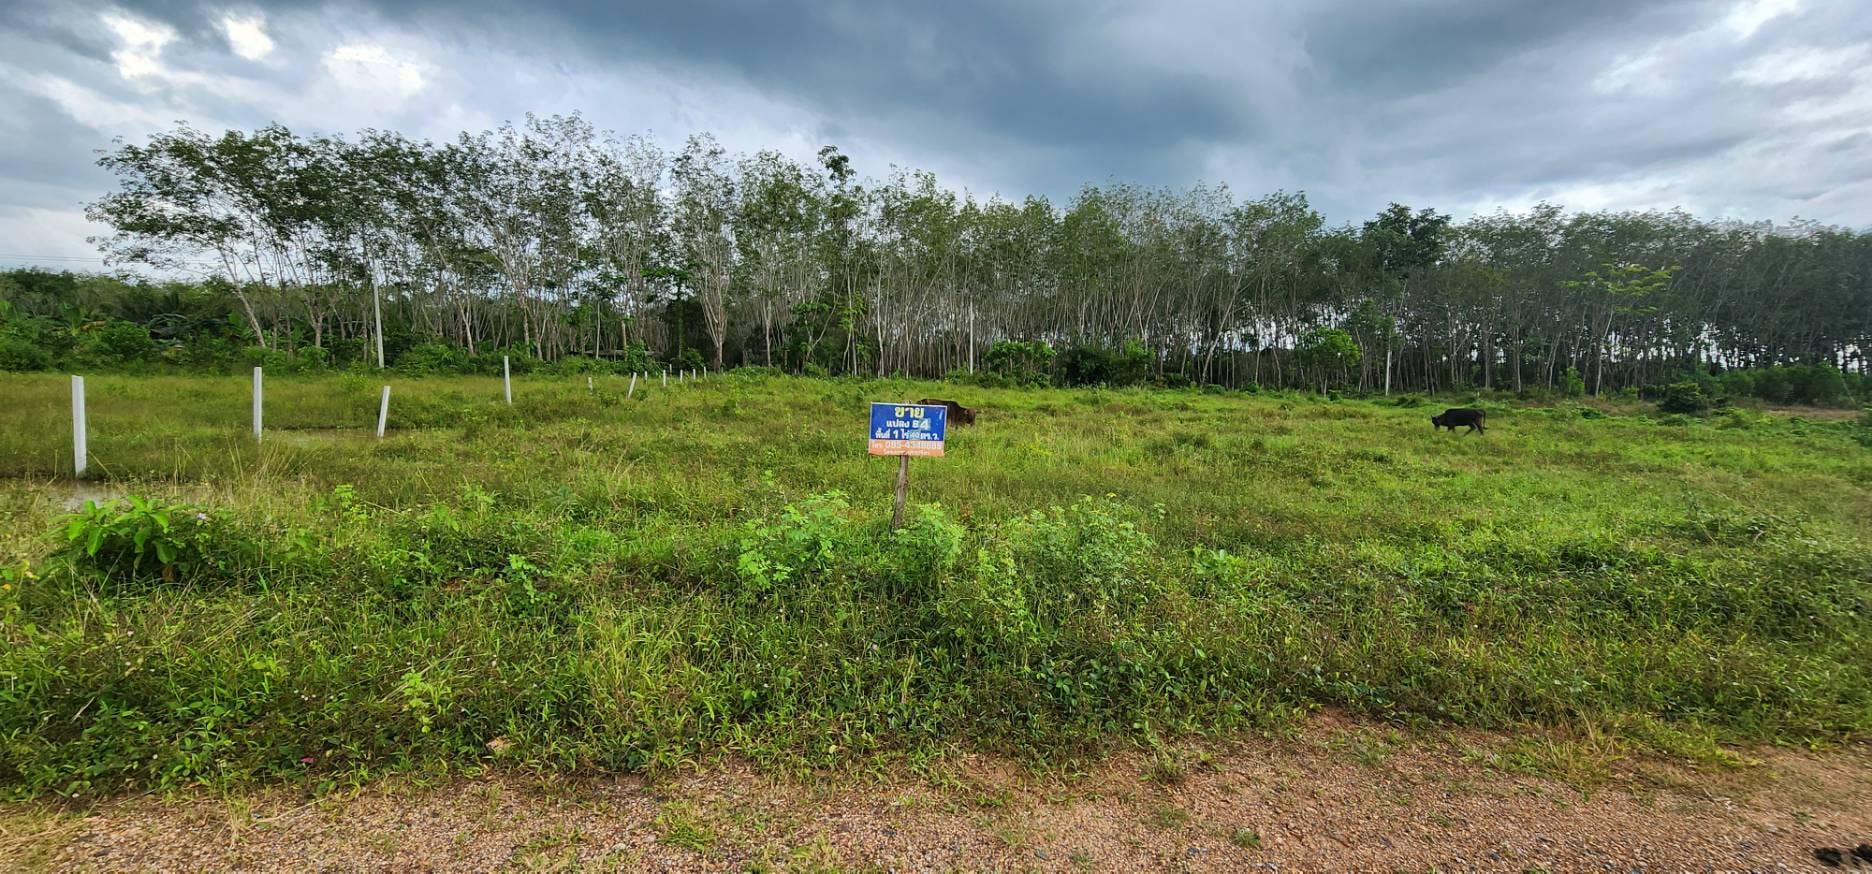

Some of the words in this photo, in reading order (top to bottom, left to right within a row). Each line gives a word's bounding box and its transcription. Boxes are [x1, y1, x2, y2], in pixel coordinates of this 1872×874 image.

[895, 406, 924, 418] ขาย
[886, 419, 910, 428] แปลง
[875, 427, 891, 438] พื้นที่
